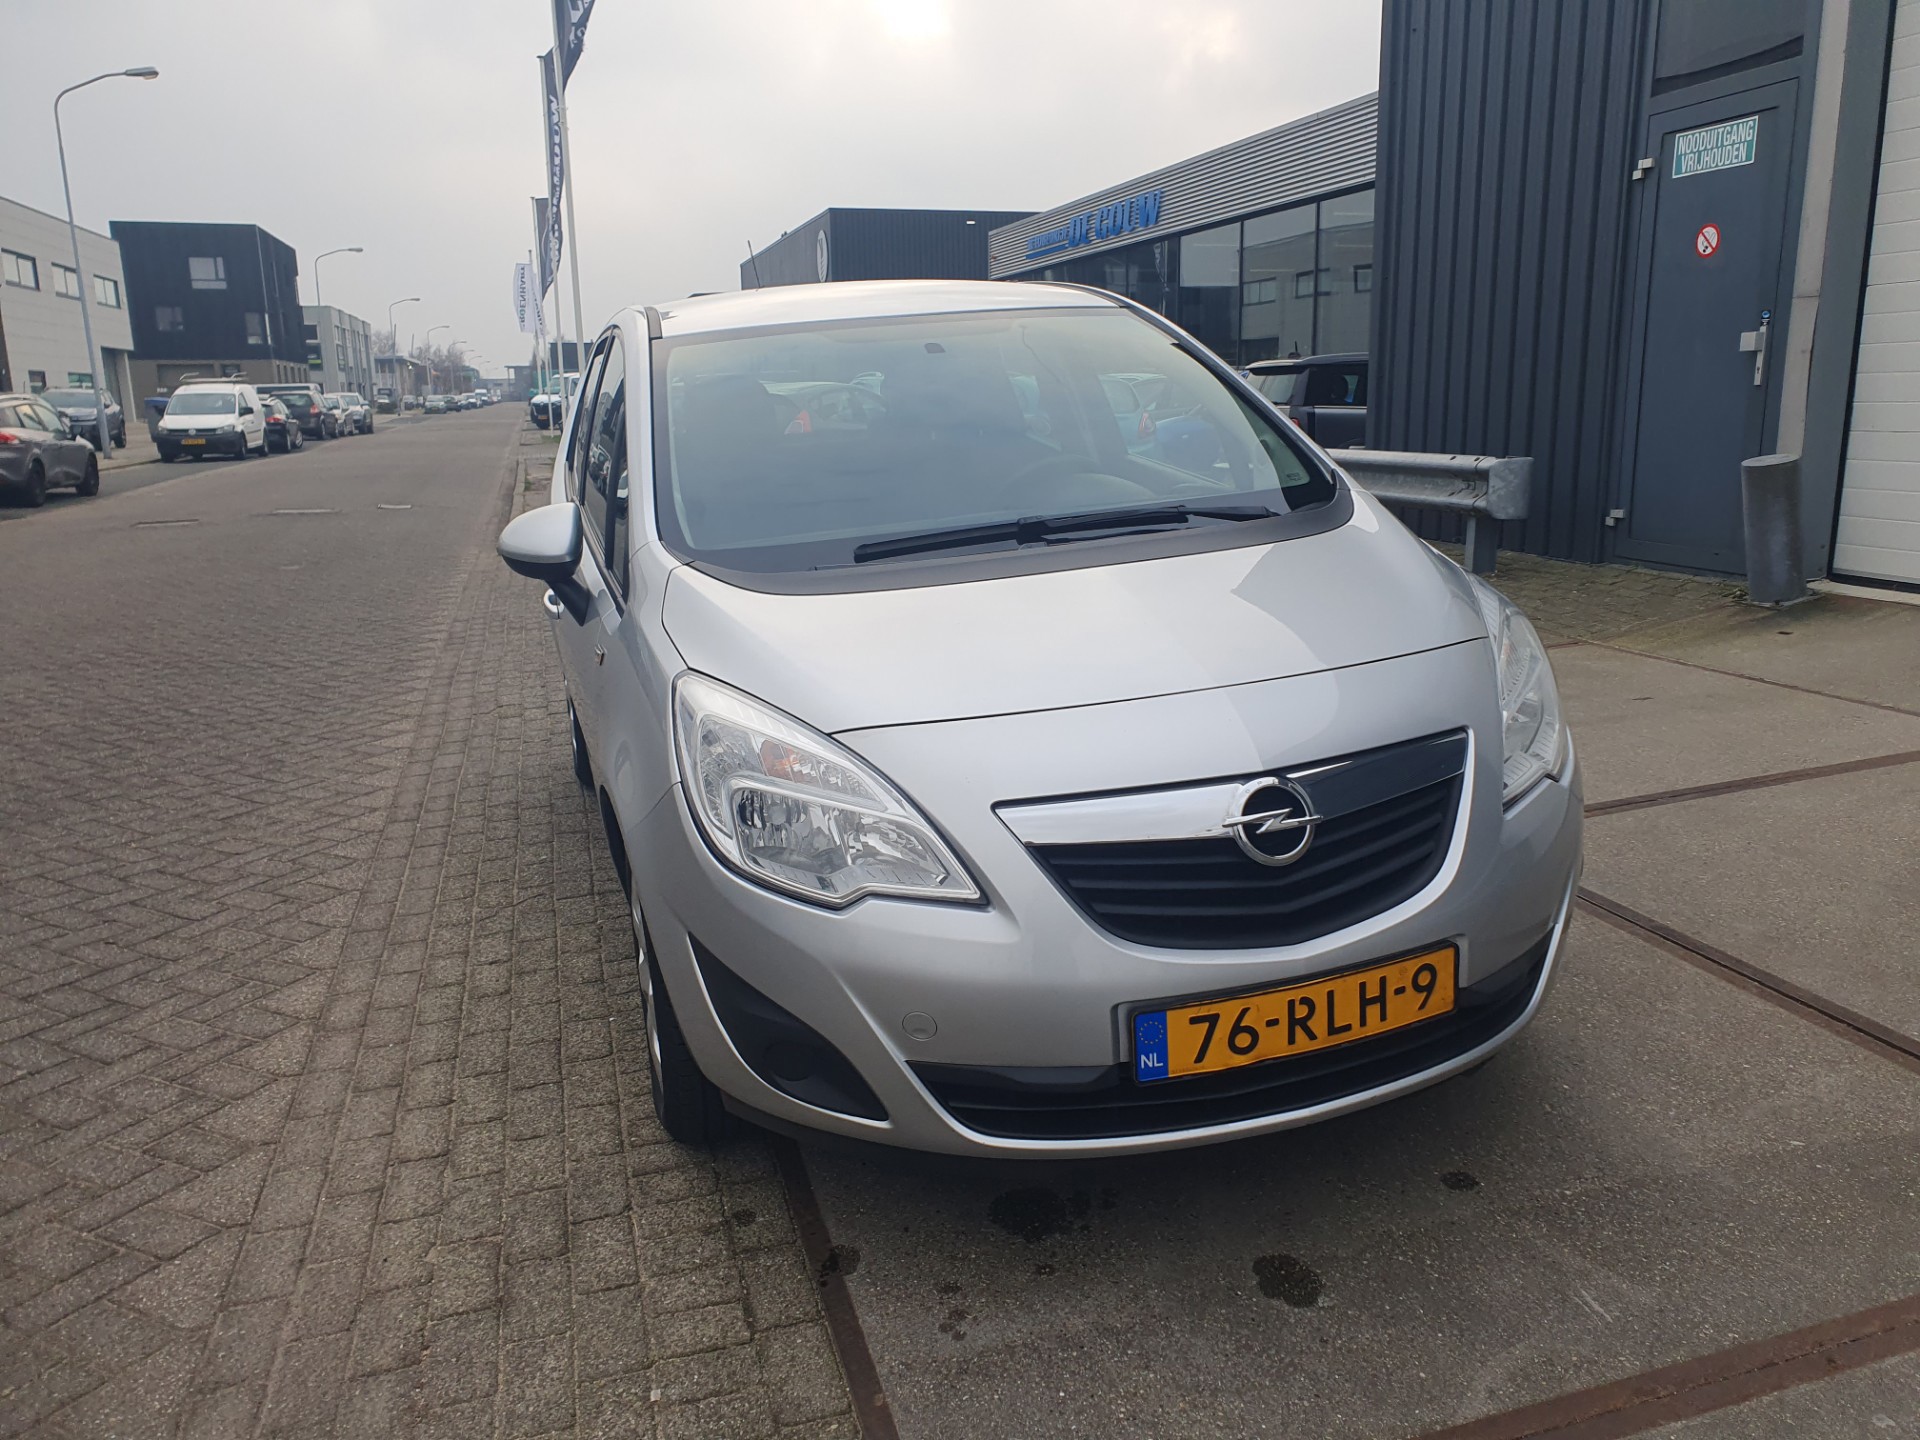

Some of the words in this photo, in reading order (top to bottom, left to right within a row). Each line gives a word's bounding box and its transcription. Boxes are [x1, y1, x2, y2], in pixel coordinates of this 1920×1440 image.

[1679, 121, 1753, 154] NOODUITGANG
[1681, 142, 1747, 173] VRIJHOUDEN
[1068, 211, 1092, 247] DE
[1095, 189, 1162, 240] GOUW
[1188, 962, 1438, 1064] 76-RLH-9
[1140, 1052, 1164, 1069] NL
